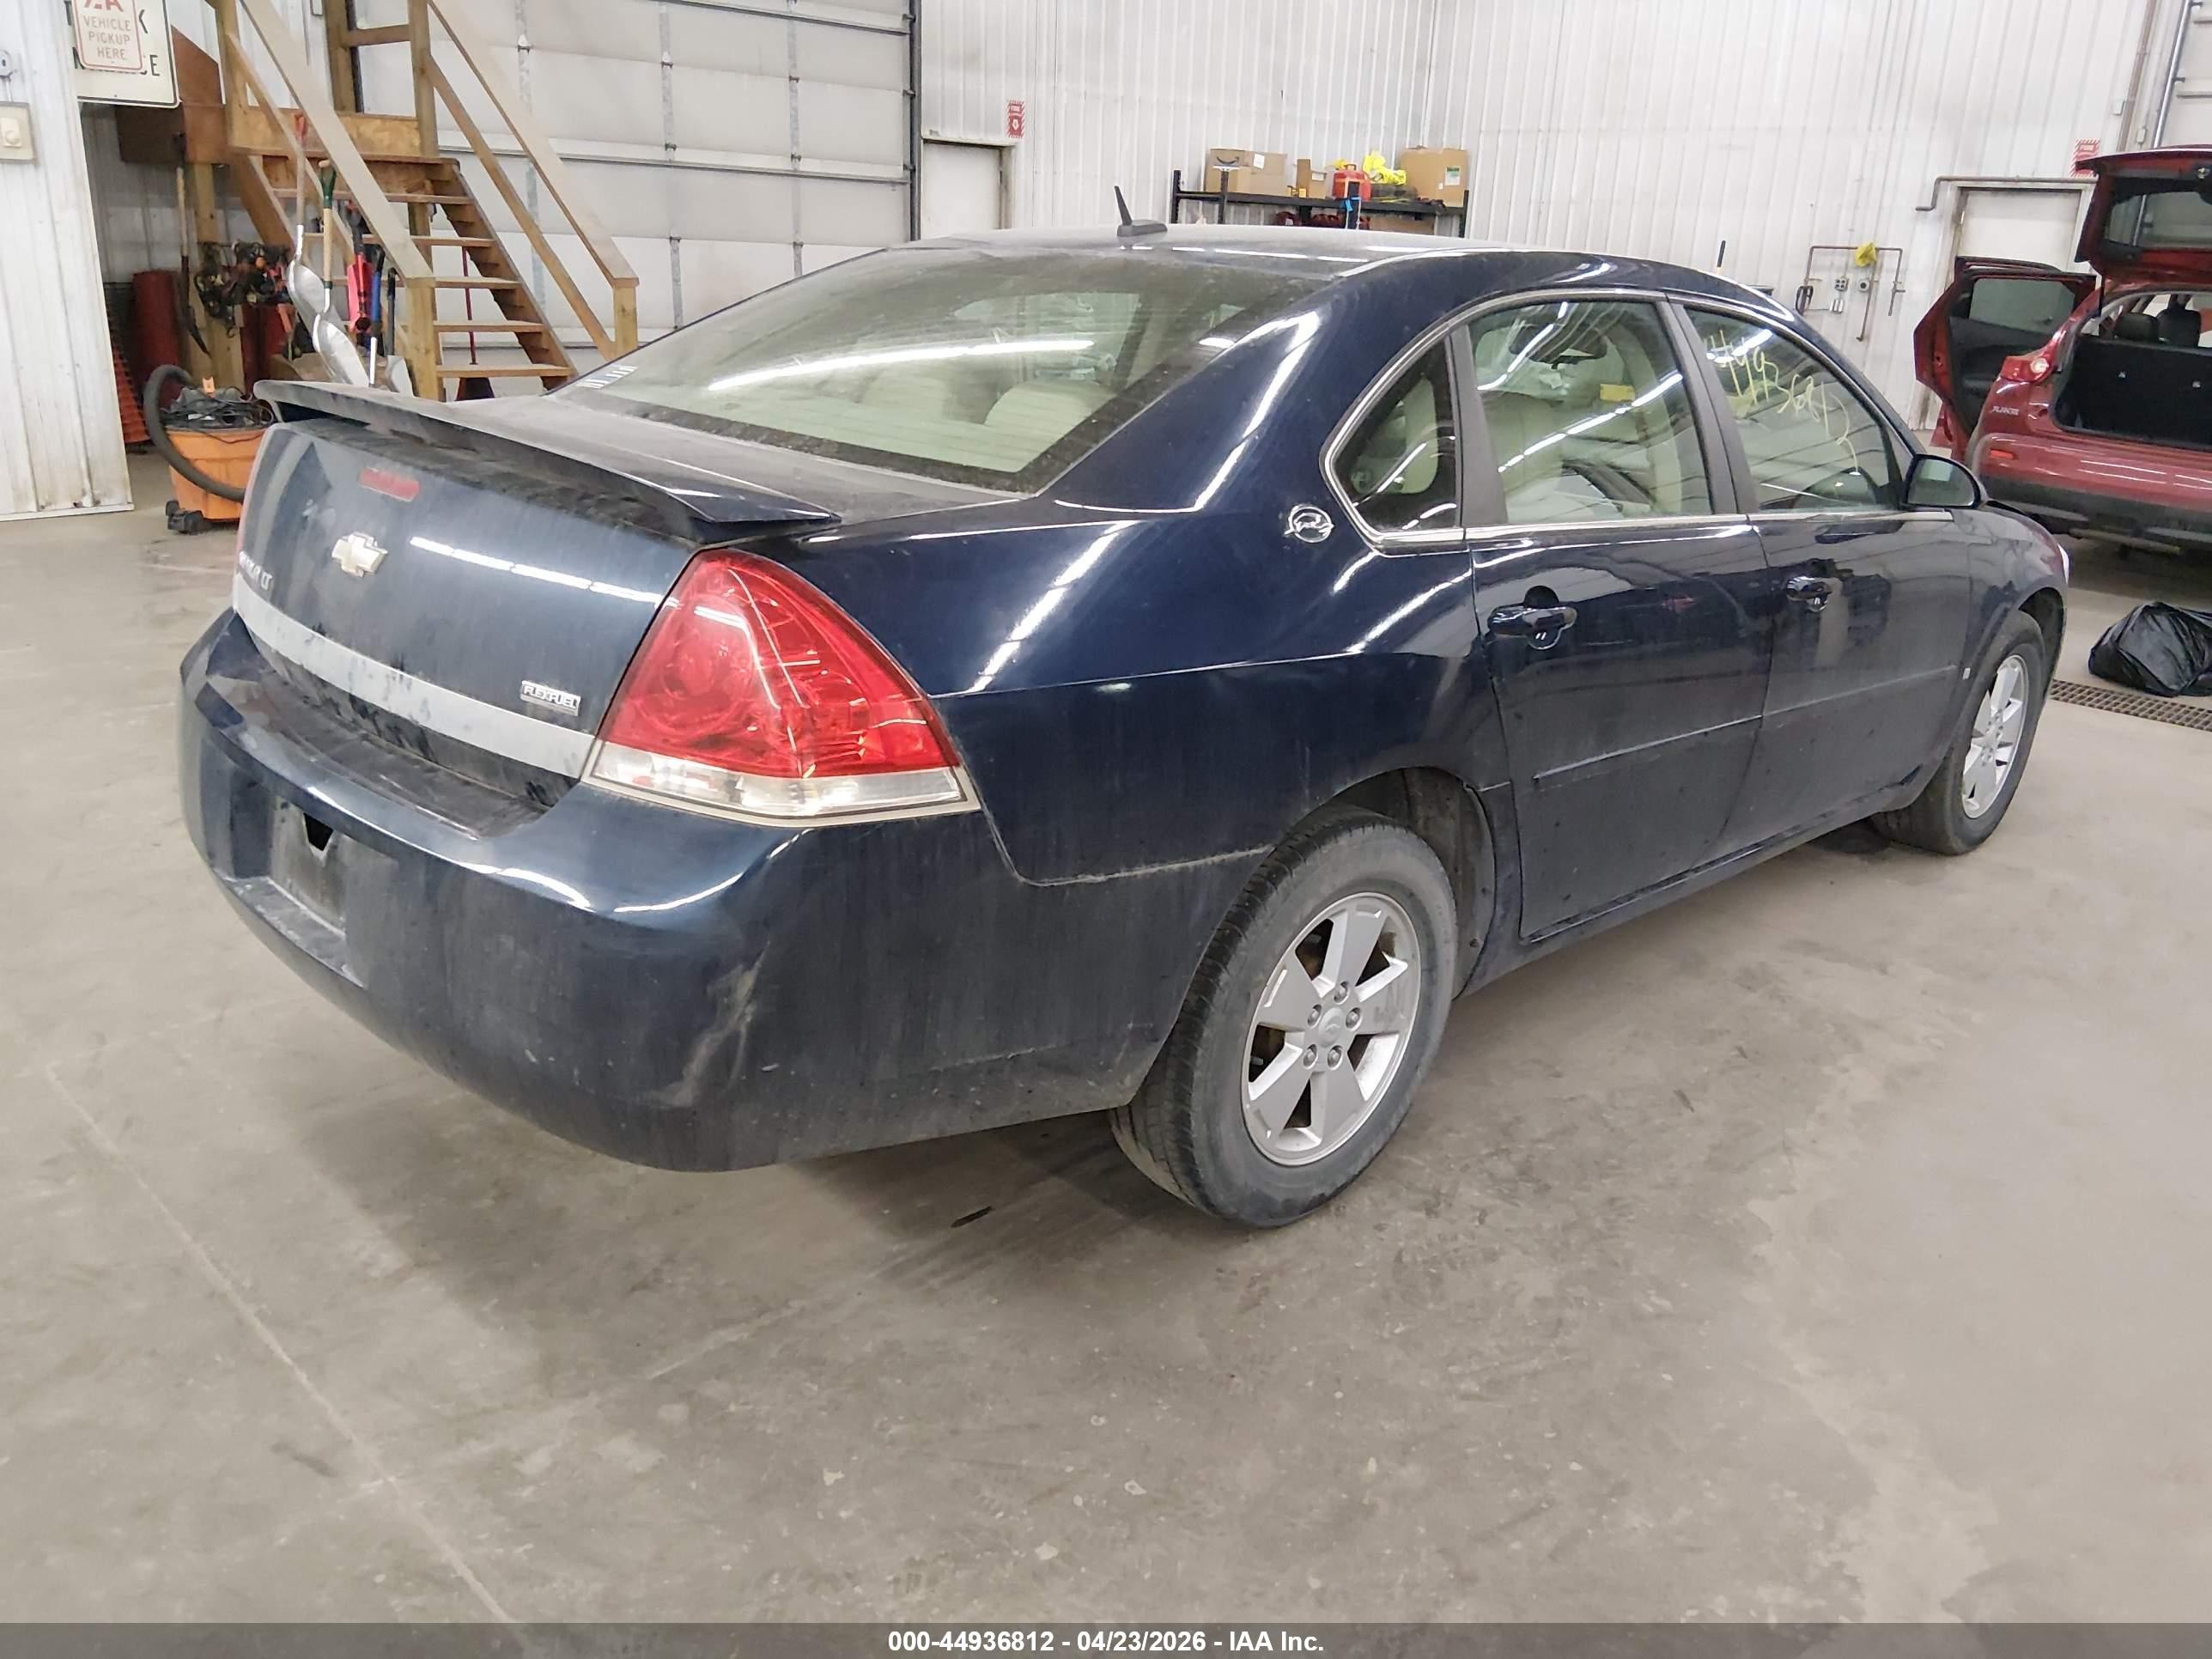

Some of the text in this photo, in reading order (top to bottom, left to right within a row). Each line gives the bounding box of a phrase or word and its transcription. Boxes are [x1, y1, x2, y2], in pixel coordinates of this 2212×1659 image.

[83, 15, 131, 32] VEHICLE
[88, 31, 131, 46] PICKUP
[96, 46, 127, 60] HERE
[523, 685, 578, 710] FLEXFUEL
